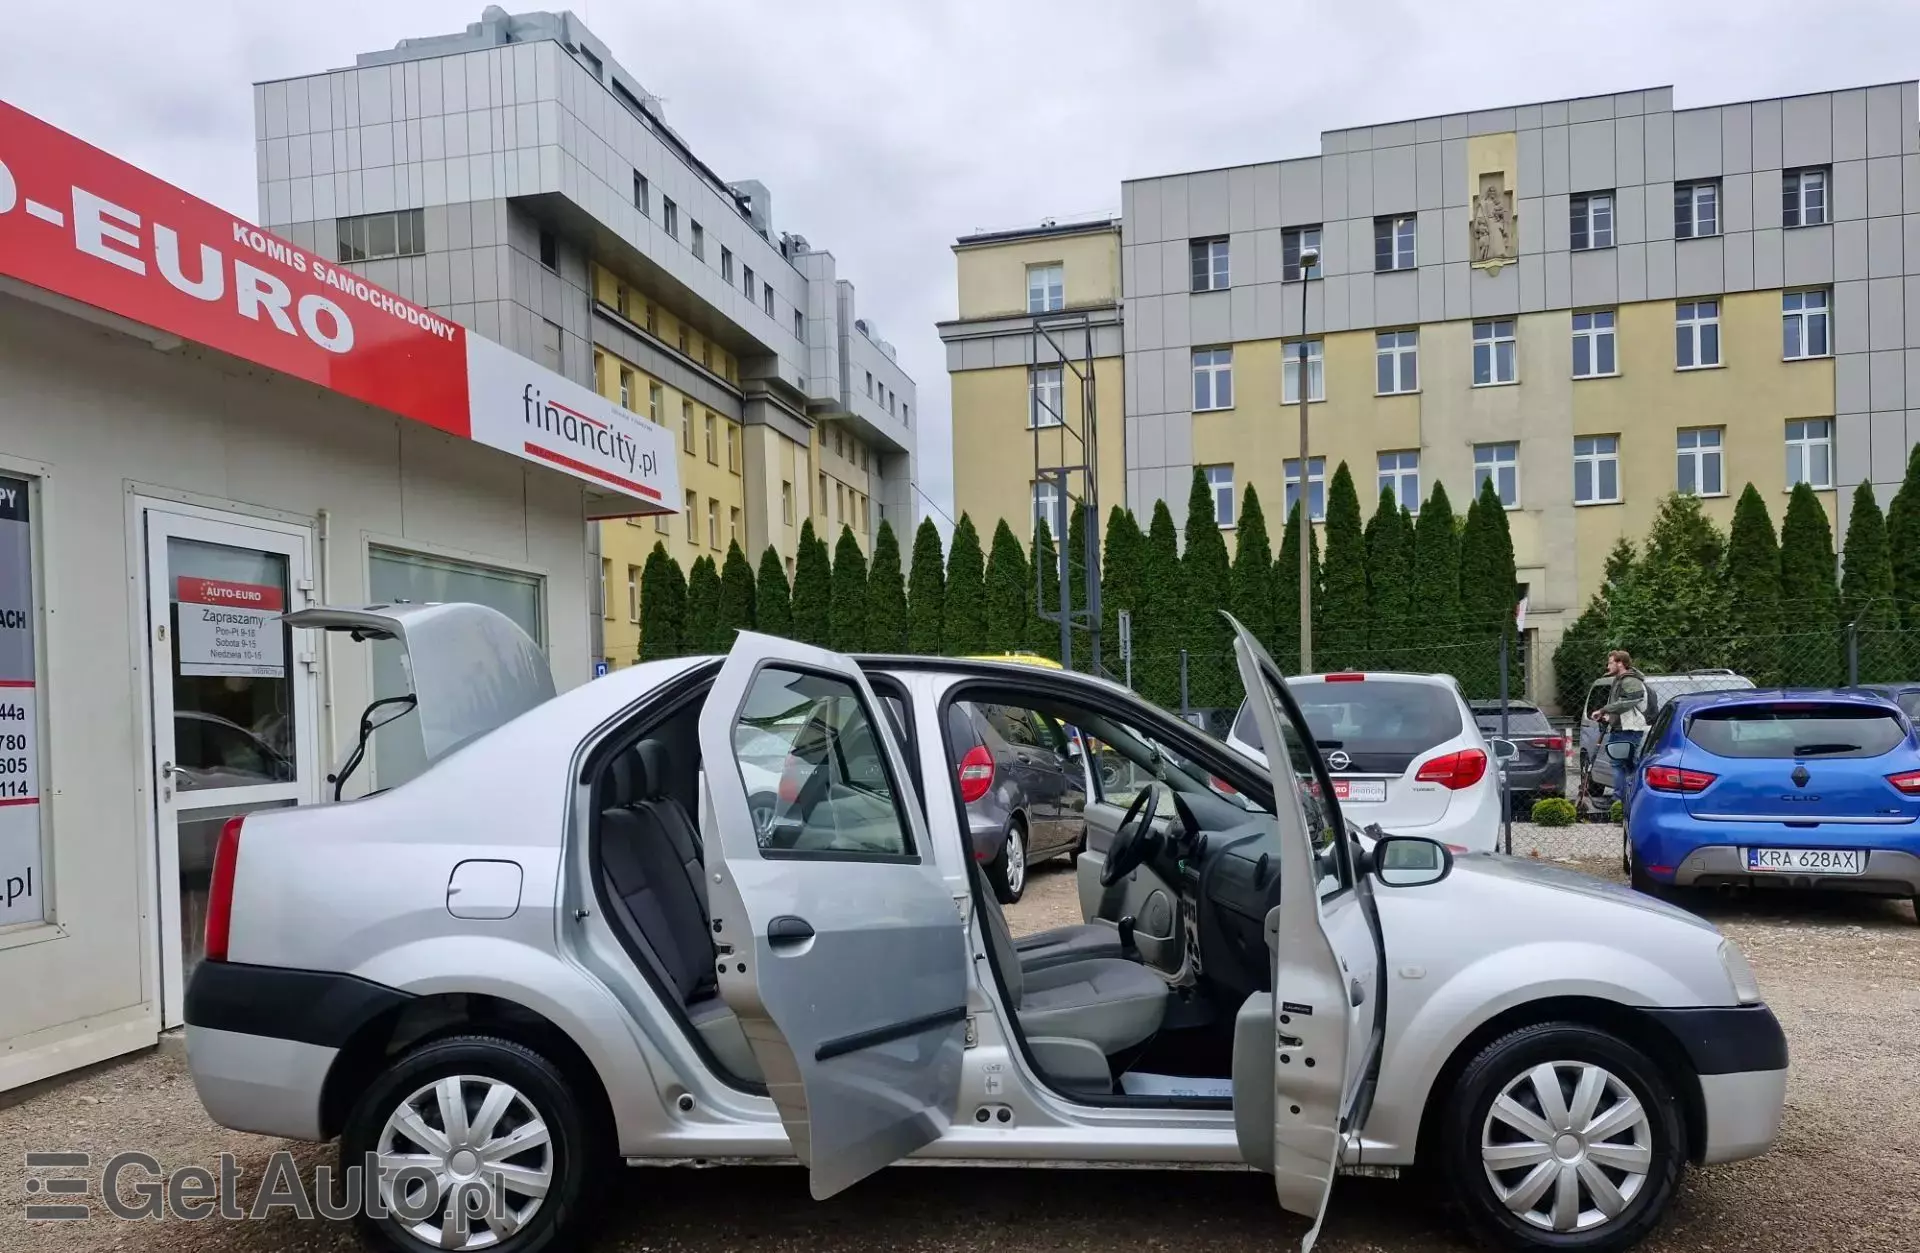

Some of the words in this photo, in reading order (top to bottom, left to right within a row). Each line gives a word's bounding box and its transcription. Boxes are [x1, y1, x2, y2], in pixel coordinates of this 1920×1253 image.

[0, 156, 354, 354] -EURO
[232, 221, 307, 273] KOMIS
[312, 261, 456, 342] SAMOCHODOWY
[522, 383, 658, 478] financity.pl
[206, 586, 261, 601] AUTO-EURO
[215, 638, 240, 648] Sobota
[241, 639, 257, 649] 9-15
[210, 649, 242, 660] Niedziela
[243, 651, 262, 661] 10-15
[1780, 794, 1822, 802] CLIO
[1759, 850, 1792, 866] KRA
[1799, 851, 1854, 868] 628AX
